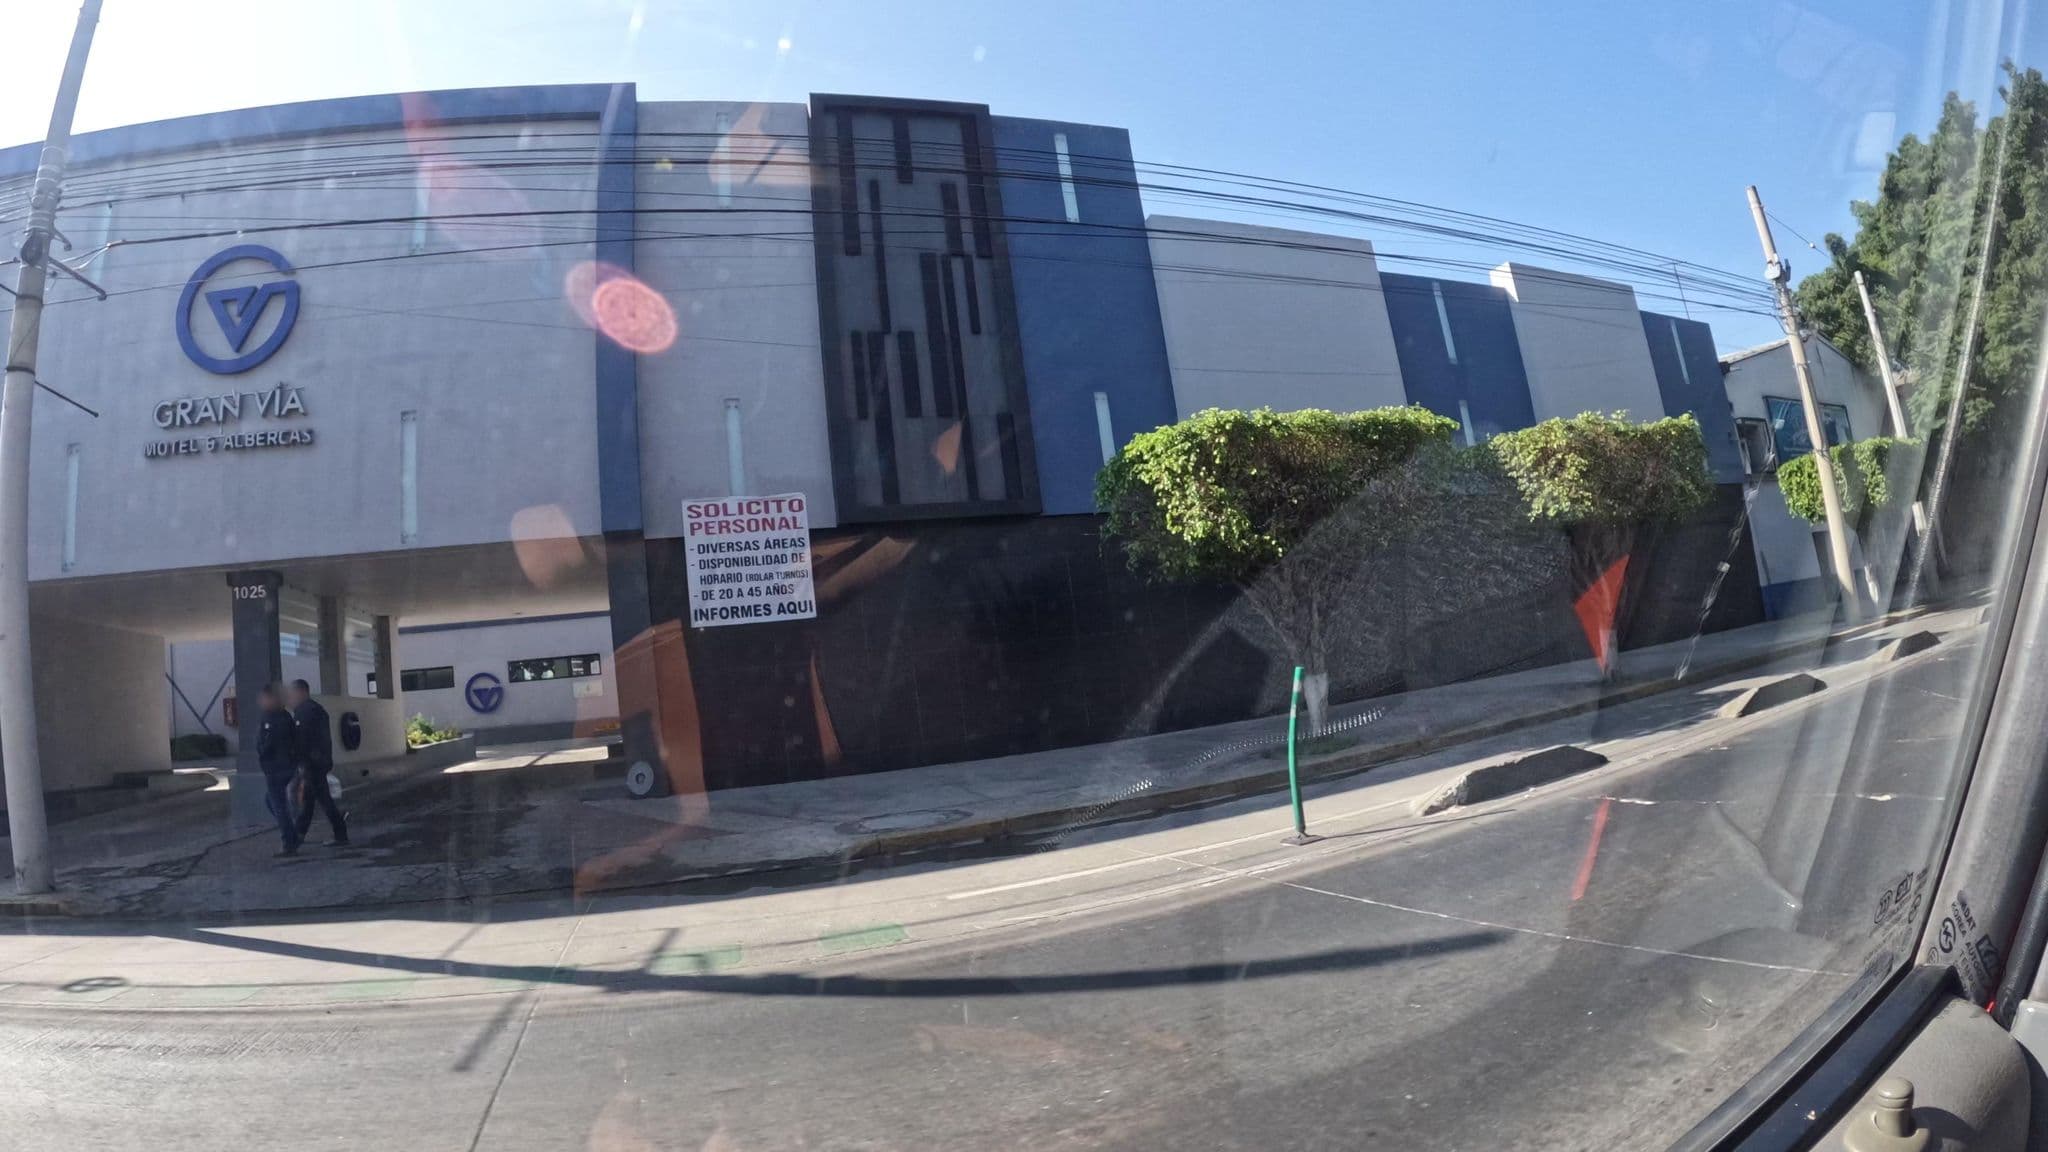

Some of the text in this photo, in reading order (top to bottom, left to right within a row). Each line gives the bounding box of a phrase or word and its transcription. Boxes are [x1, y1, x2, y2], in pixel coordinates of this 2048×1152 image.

[154, 382, 306, 428] GRAN VÍA
[145, 430, 313, 458] MOTEL & ALBERCAS
[687, 498, 804, 518] SOLICITO
[690, 516, 803, 536] PERSONAL
[697, 540, 760, 554] DIVERSAS
[764, 537, 806, 550] ÁREAS
[699, 554, 788, 570] DISPONIBILIDAD
[791, 553, 805, 563] DE
[700, 569, 809, 585] HORARIO (ROLAR TURNOS)
[234, 584, 266, 600] 1025
[702, 590, 715, 601] DE
[718, 588, 733, 600] 20
[737, 587, 744, 598] A
[747, 586, 761, 597] 45
[765, 583, 794, 596] AÑOS
[694, 600, 813, 622] INFORMES AQUI
